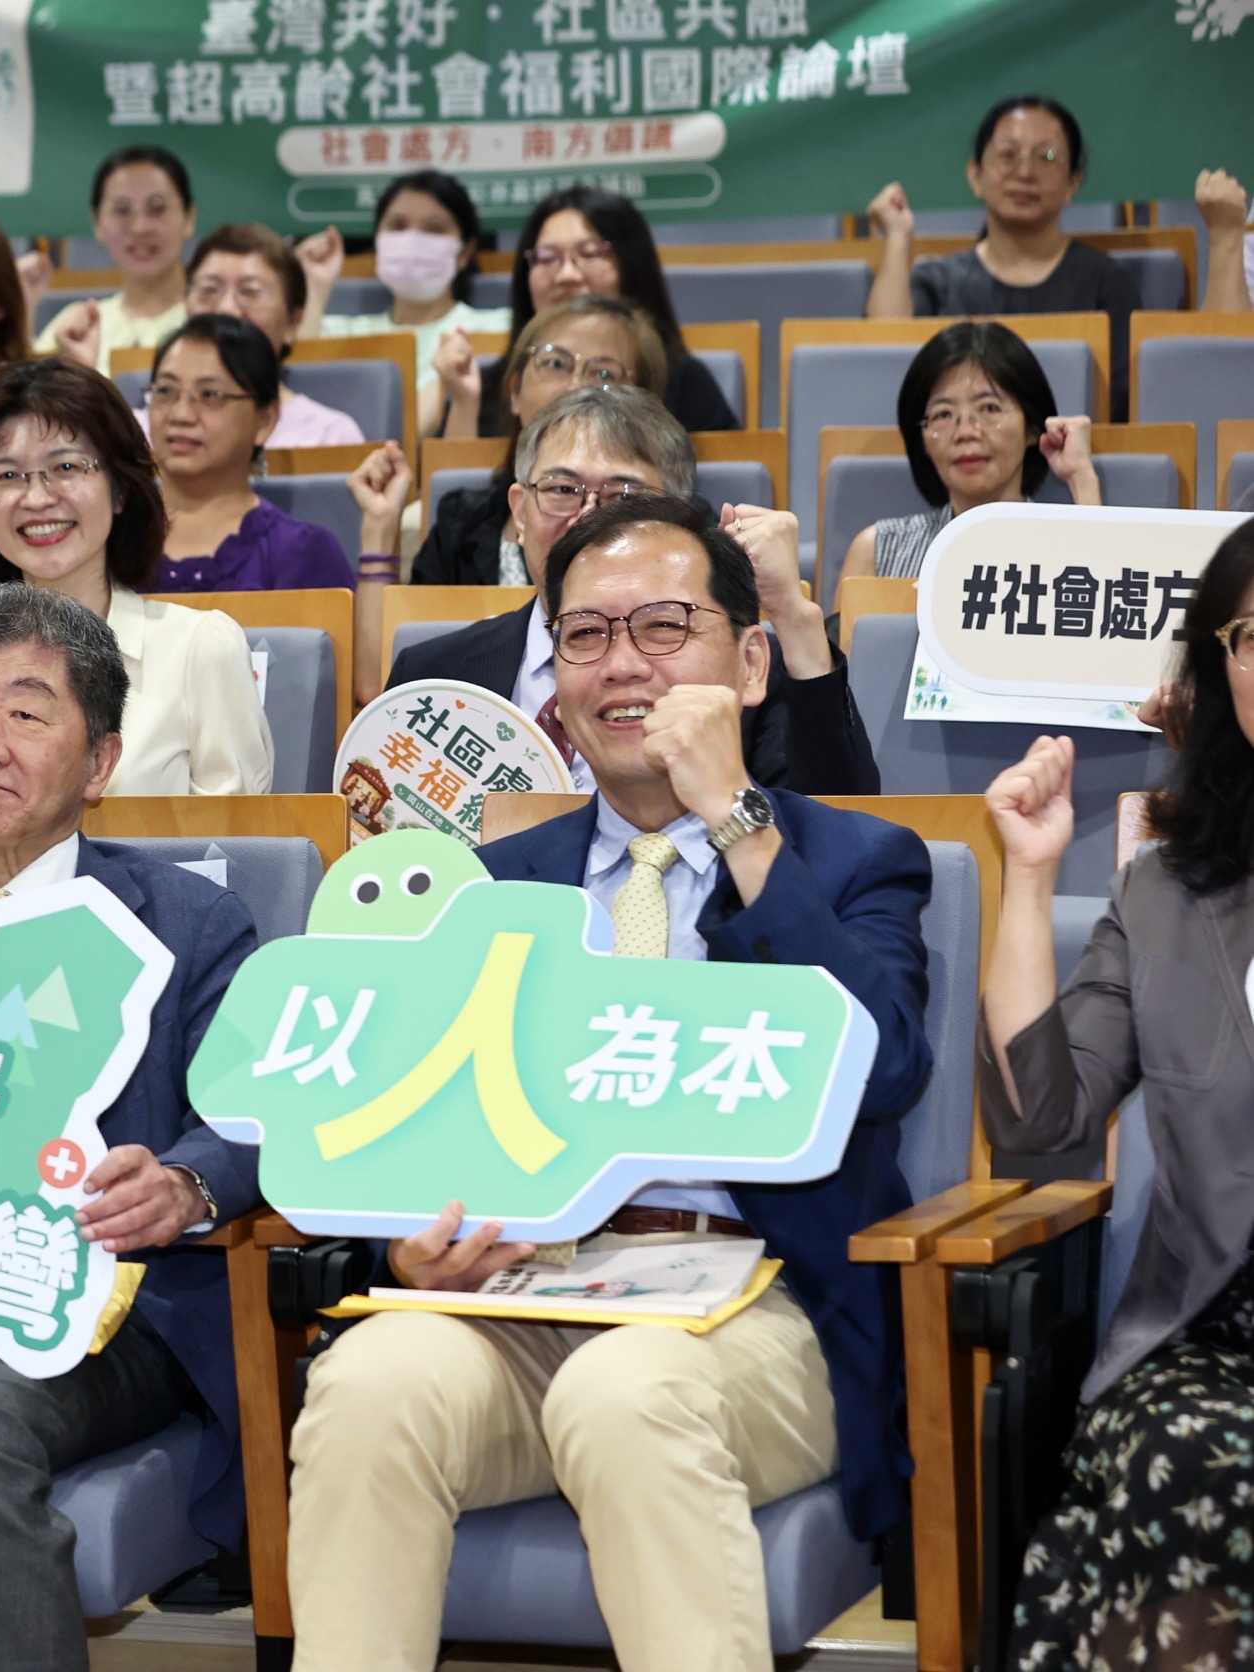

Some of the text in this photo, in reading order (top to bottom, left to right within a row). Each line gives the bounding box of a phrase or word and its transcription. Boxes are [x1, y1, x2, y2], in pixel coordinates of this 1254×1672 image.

[103, 31, 909, 125] 暨超高齡社會福利國際論壇
[961, 563, 1201, 641] #社會處方
[252, 931, 805, 1175] 以人為本
